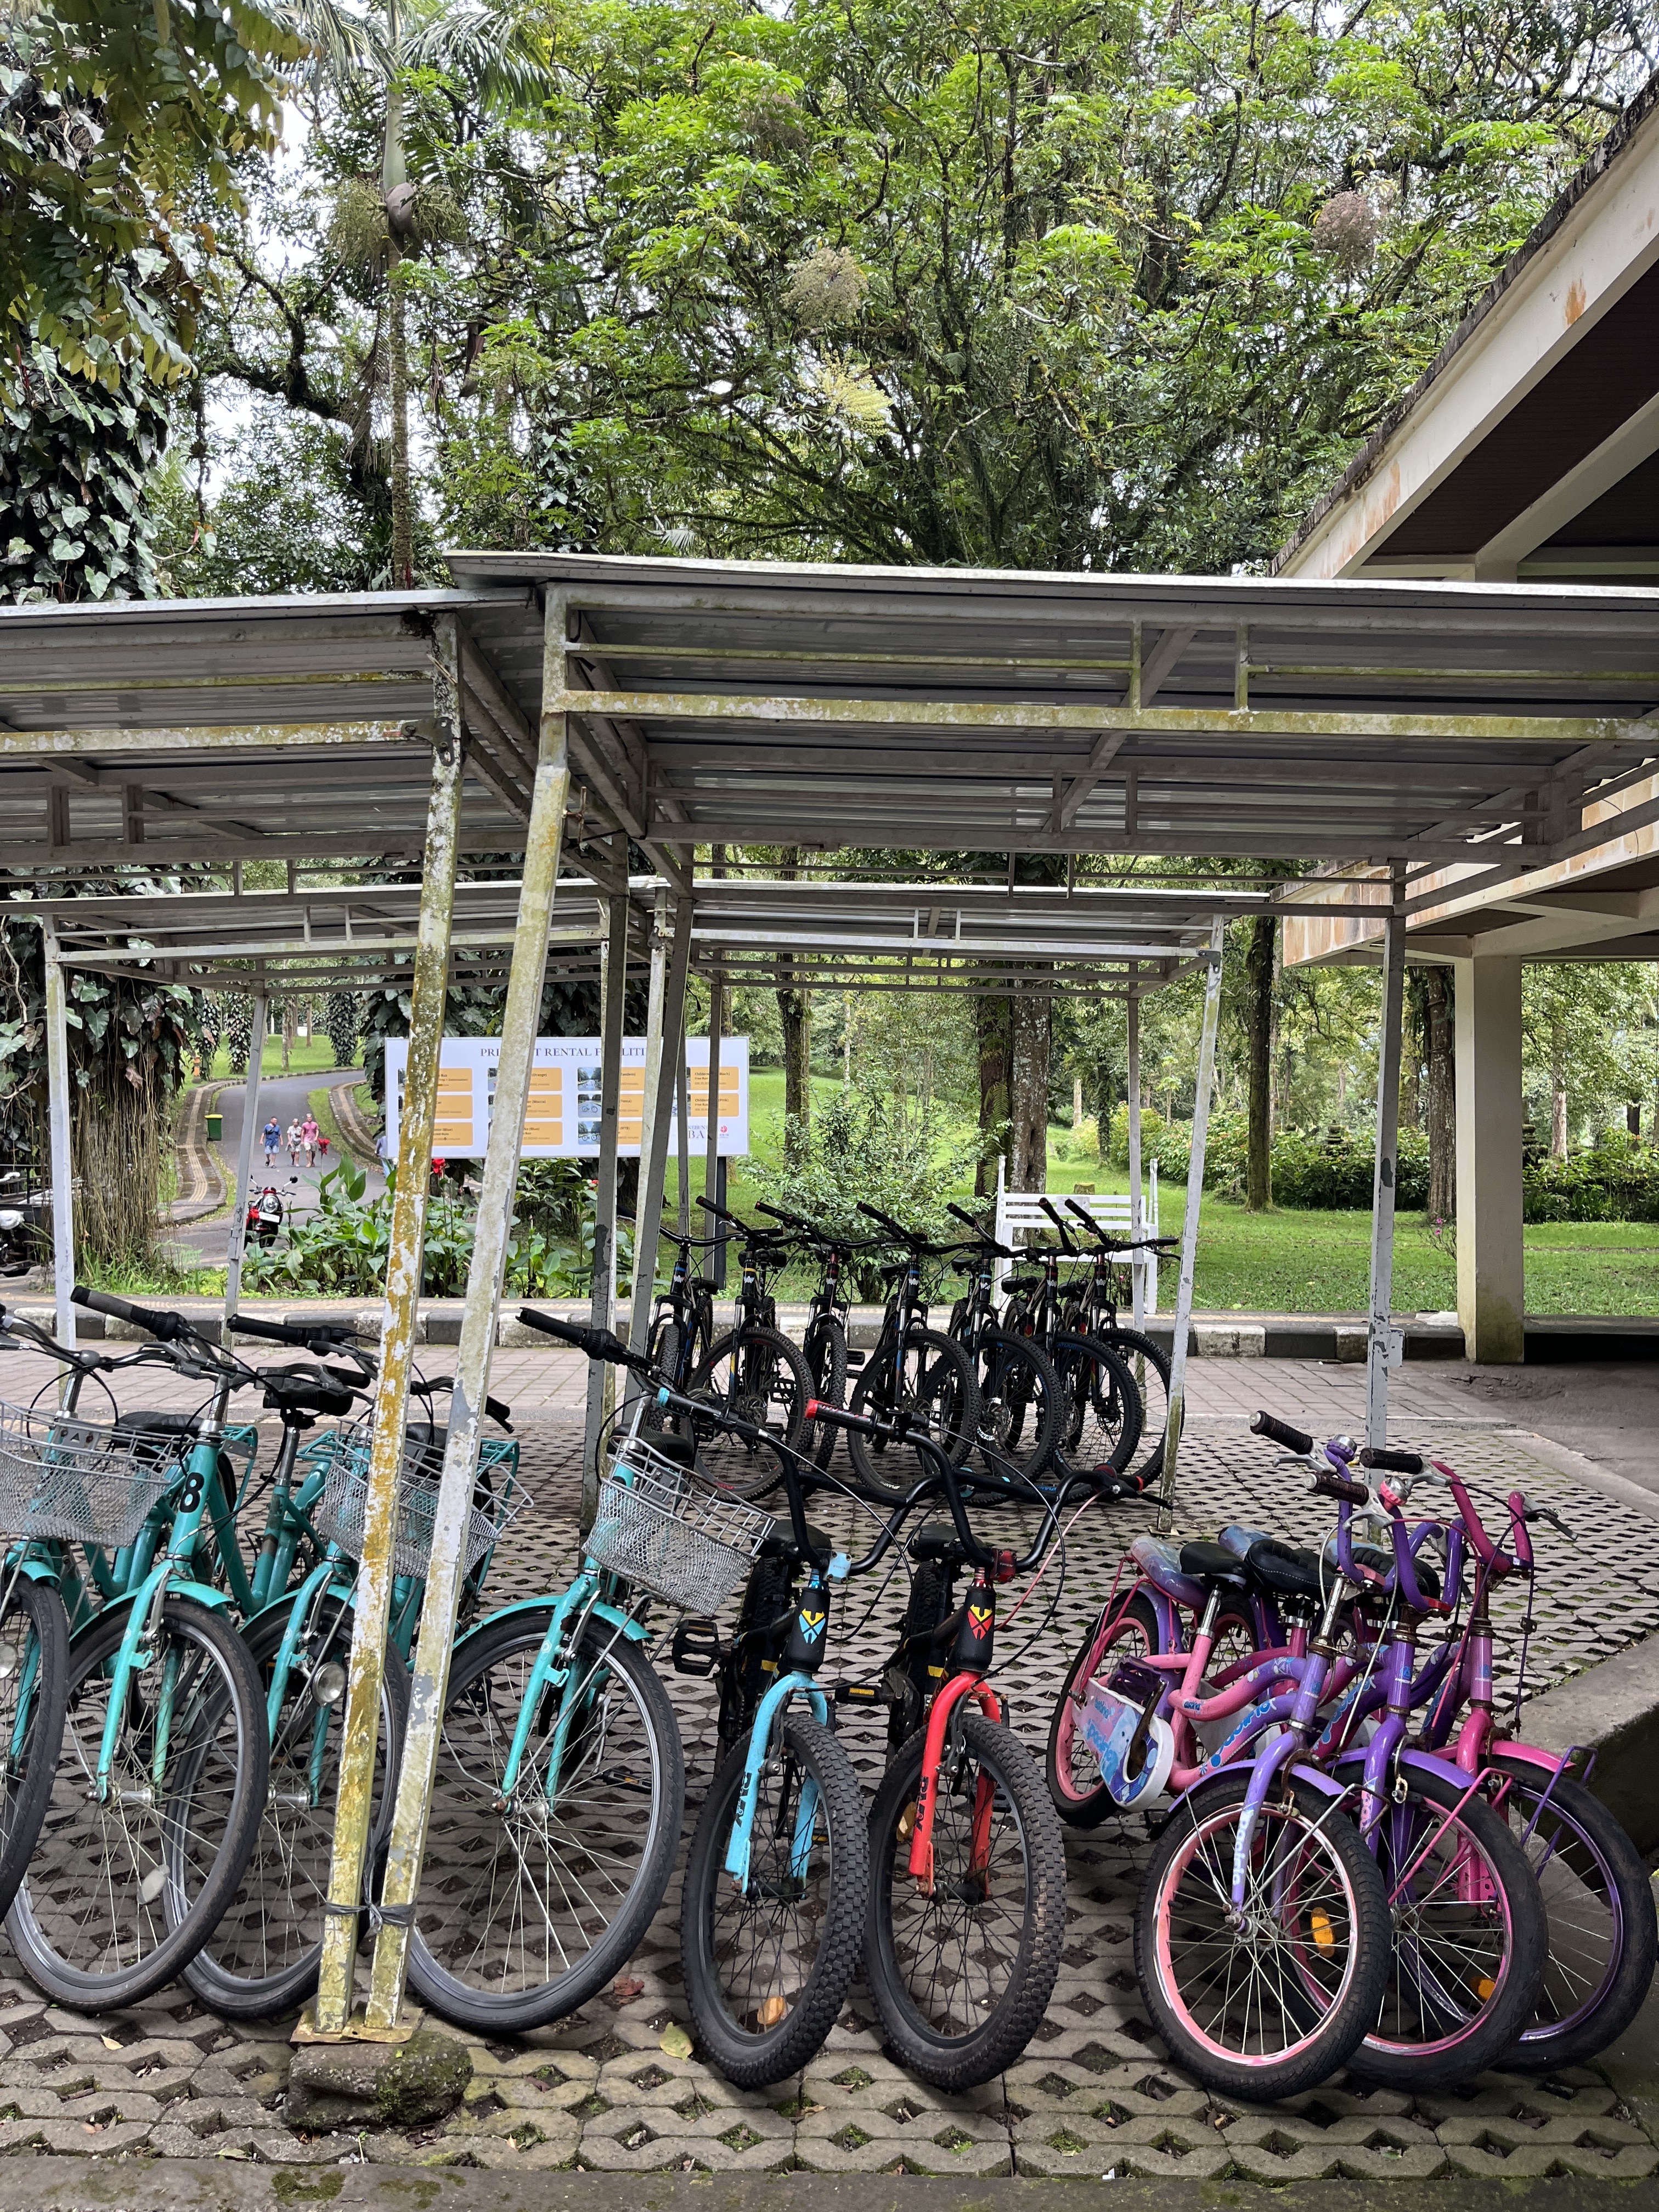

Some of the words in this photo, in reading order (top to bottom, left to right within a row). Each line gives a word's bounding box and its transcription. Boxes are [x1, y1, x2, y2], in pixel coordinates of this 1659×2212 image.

[544, 1047, 592, 1057] RENTAL
[687, 1130, 705, 1139] BA
[179, 1472, 205, 1513] 8
